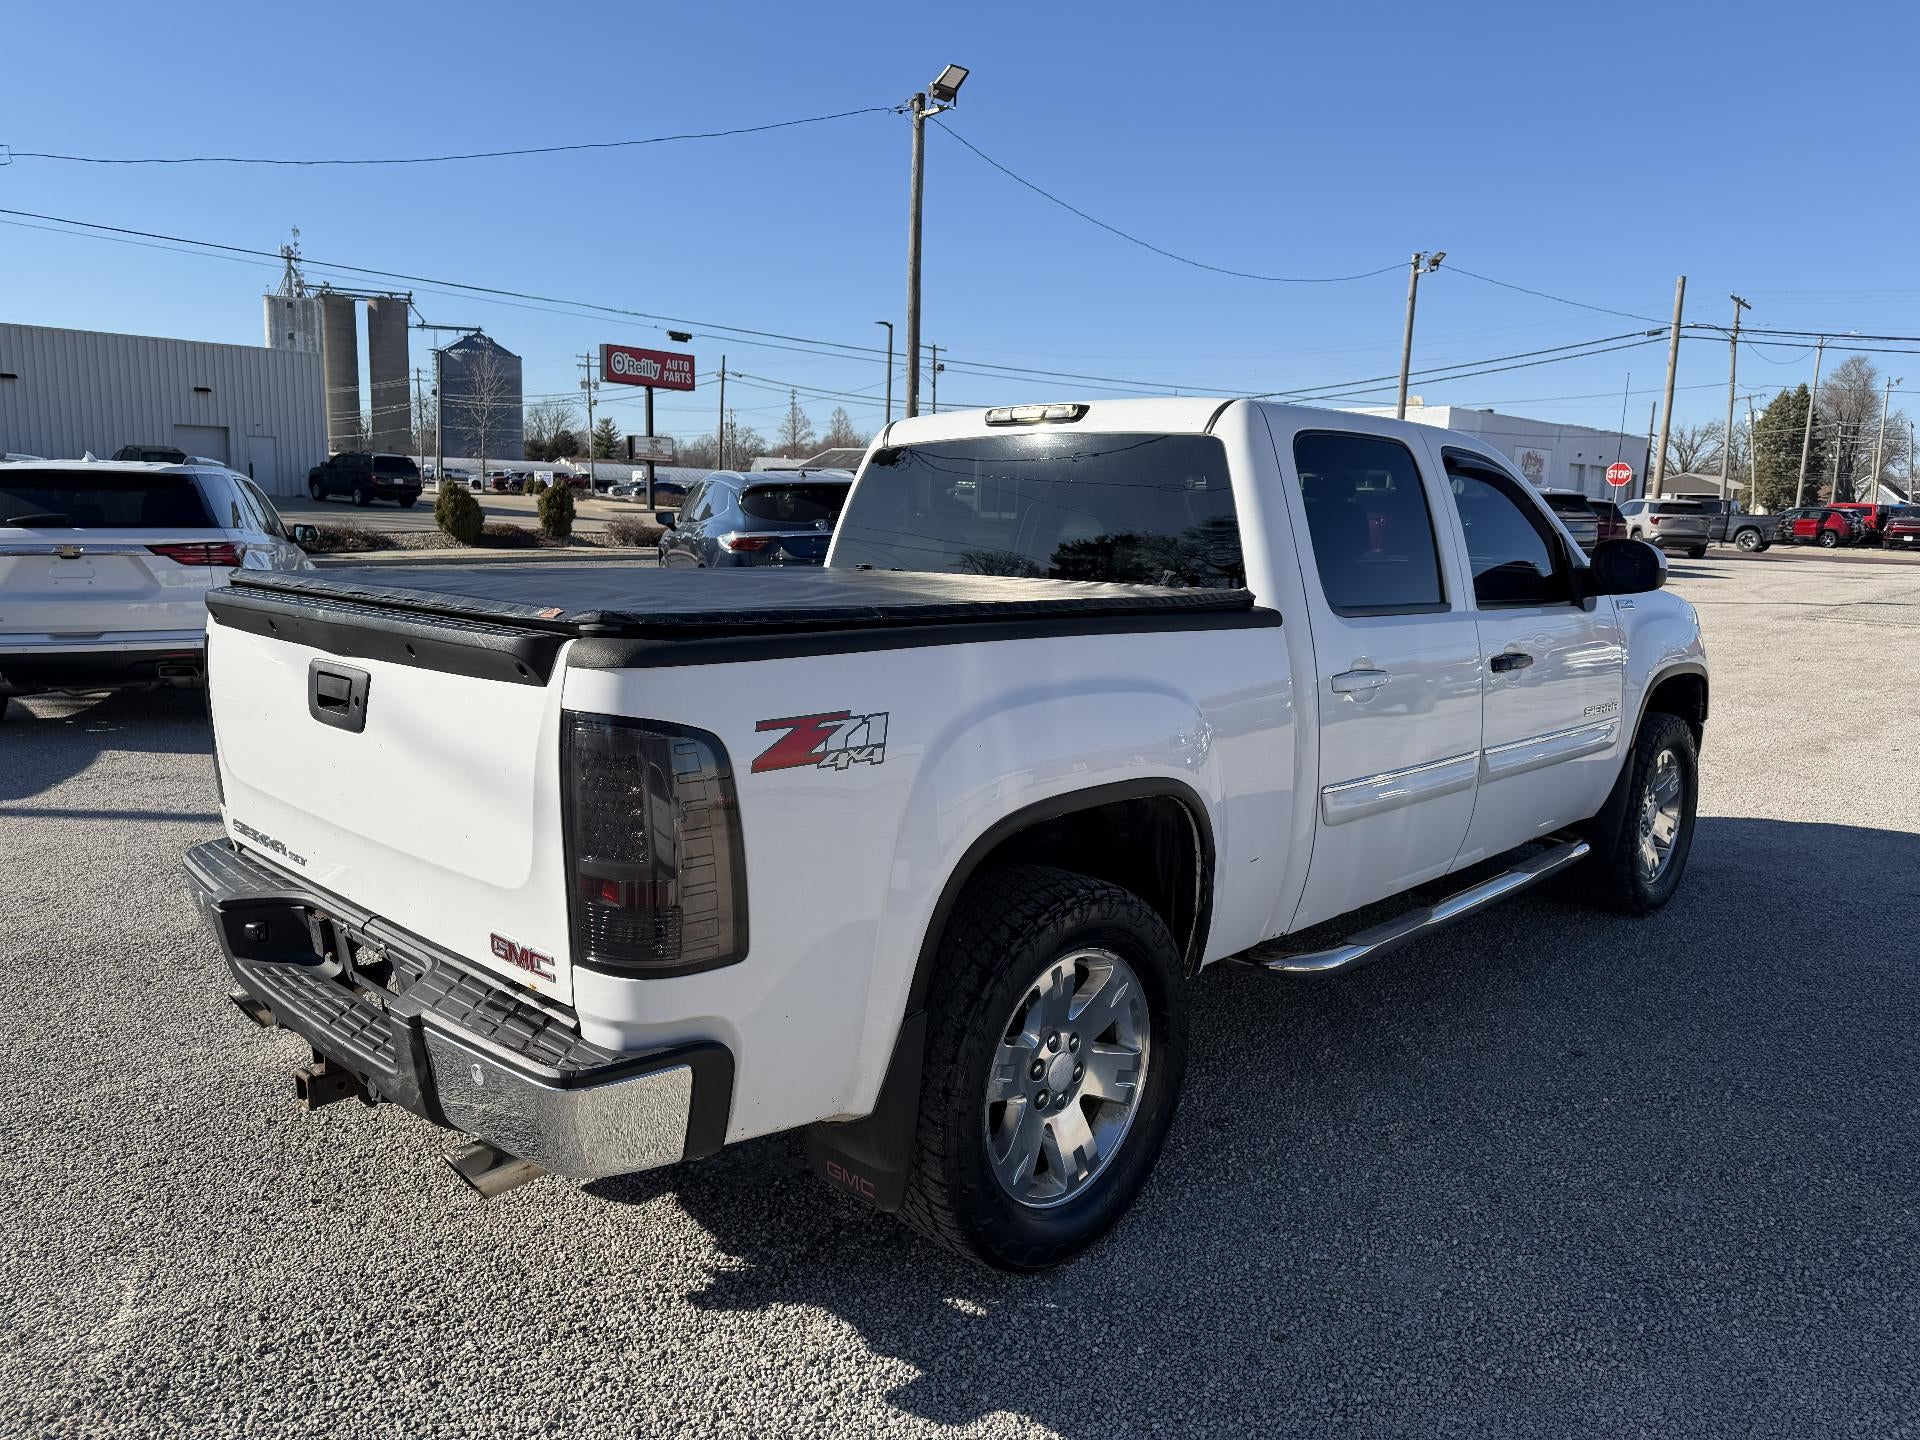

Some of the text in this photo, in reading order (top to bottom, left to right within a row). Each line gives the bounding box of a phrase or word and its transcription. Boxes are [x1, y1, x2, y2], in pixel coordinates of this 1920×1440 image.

[611, 352, 661, 380] O'Reilly
[663, 371, 692, 384] PARTS
[666, 358, 690, 372] AUTO
[1607, 468, 1630, 480] STOP
[1584, 701, 1619, 717] SIERRA
[751, 710, 889, 774] Z71
[233, 818, 287, 857] SIERRA
[490, 931, 557, 984] GMC
[825, 1160, 876, 1199] GMC
